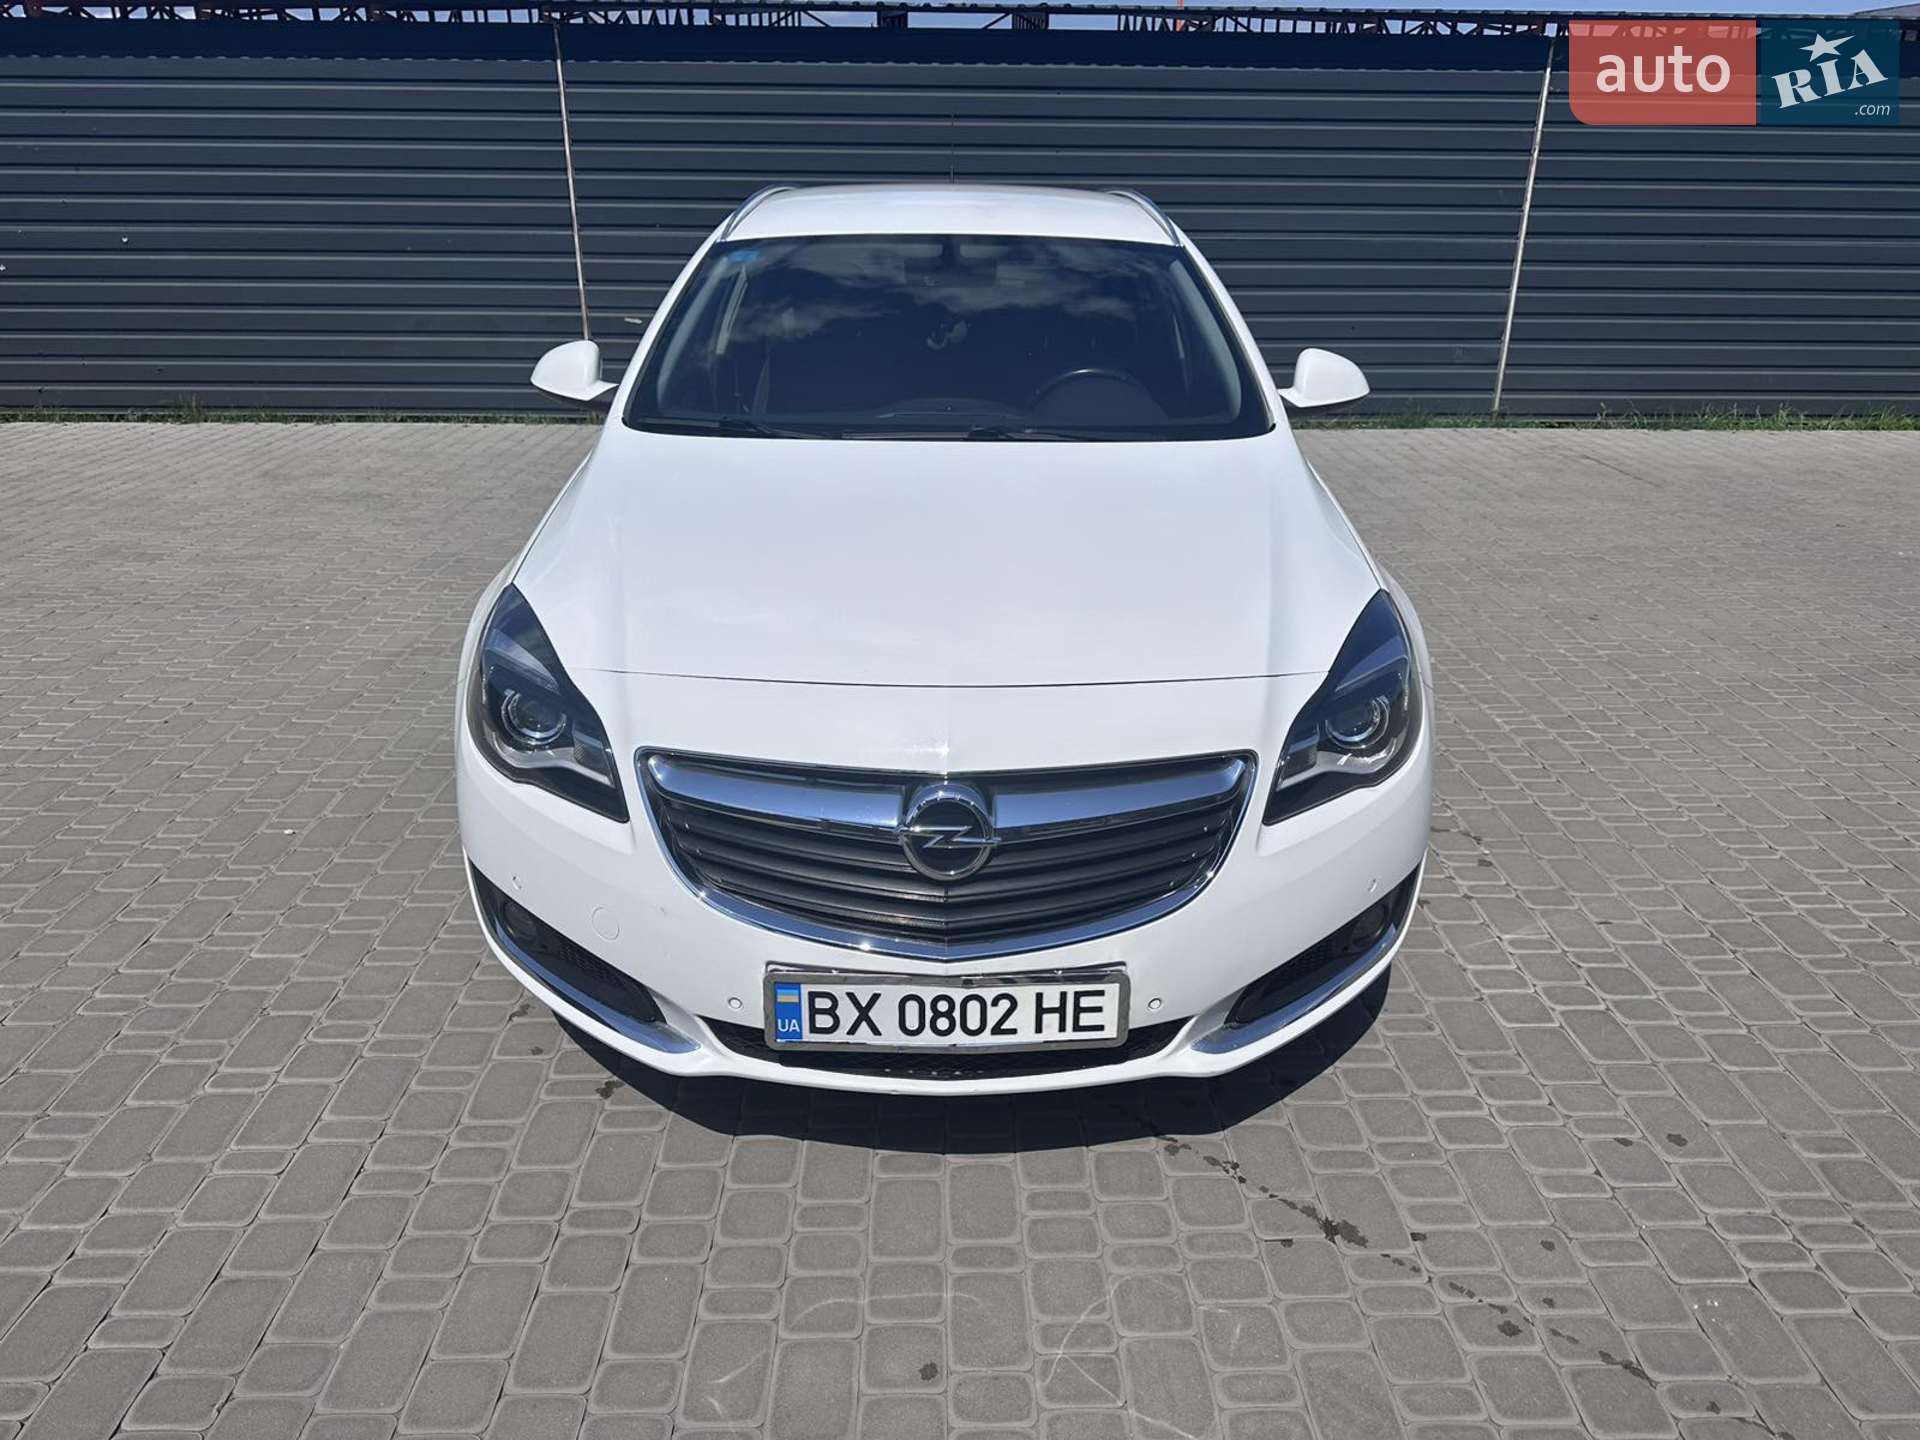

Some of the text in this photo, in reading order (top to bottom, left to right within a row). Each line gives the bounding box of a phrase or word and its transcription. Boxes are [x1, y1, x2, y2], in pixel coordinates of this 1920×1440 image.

[778, 1018, 801, 1033] UA
[807, 989, 1105, 1037] BX 0802 HE
